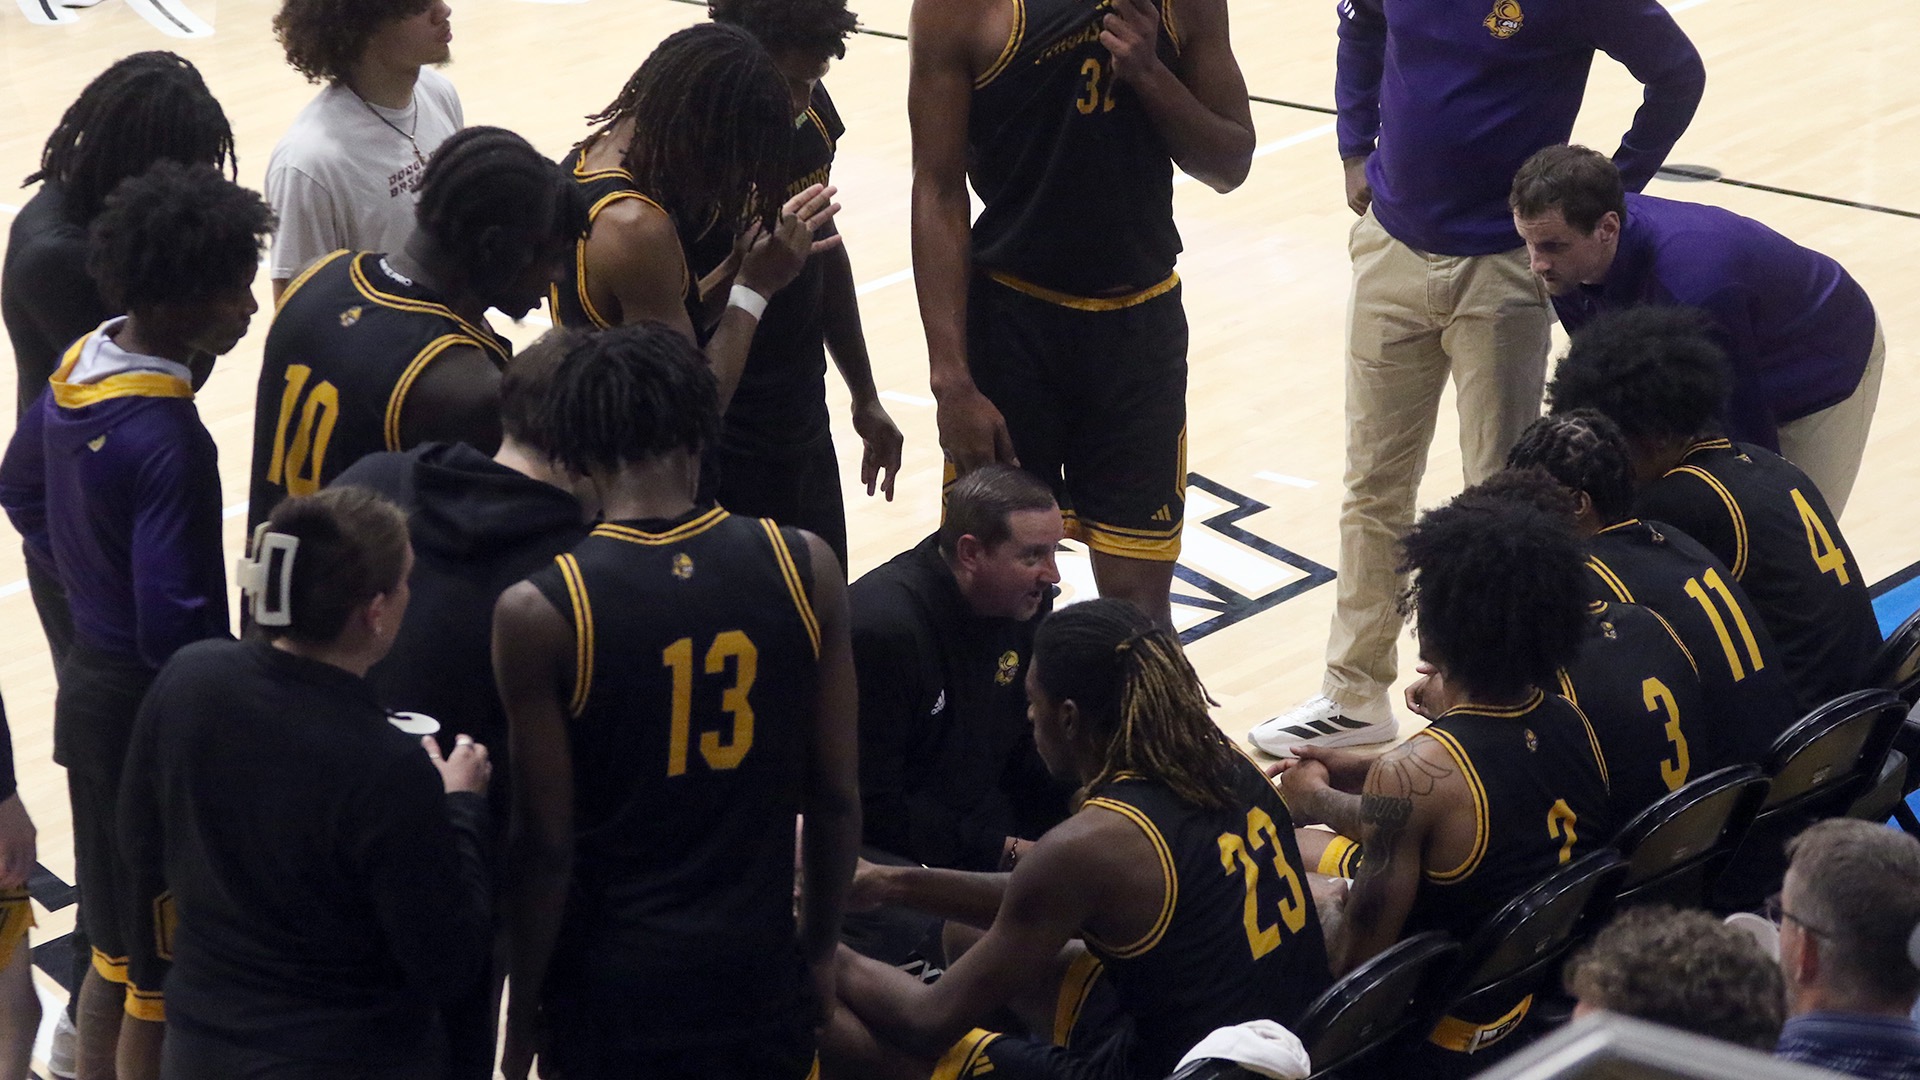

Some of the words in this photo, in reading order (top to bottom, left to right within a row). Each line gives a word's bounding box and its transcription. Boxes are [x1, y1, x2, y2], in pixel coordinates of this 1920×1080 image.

[1076, 58, 1116, 114] 3
[266, 364, 339, 497] 10
[1789, 488, 1850, 586] 4
[1684, 567, 1764, 682] 11
[663, 630, 758, 777] 13
[1642, 677, 1690, 792] 3
[1217, 806, 1306, 960] 23
